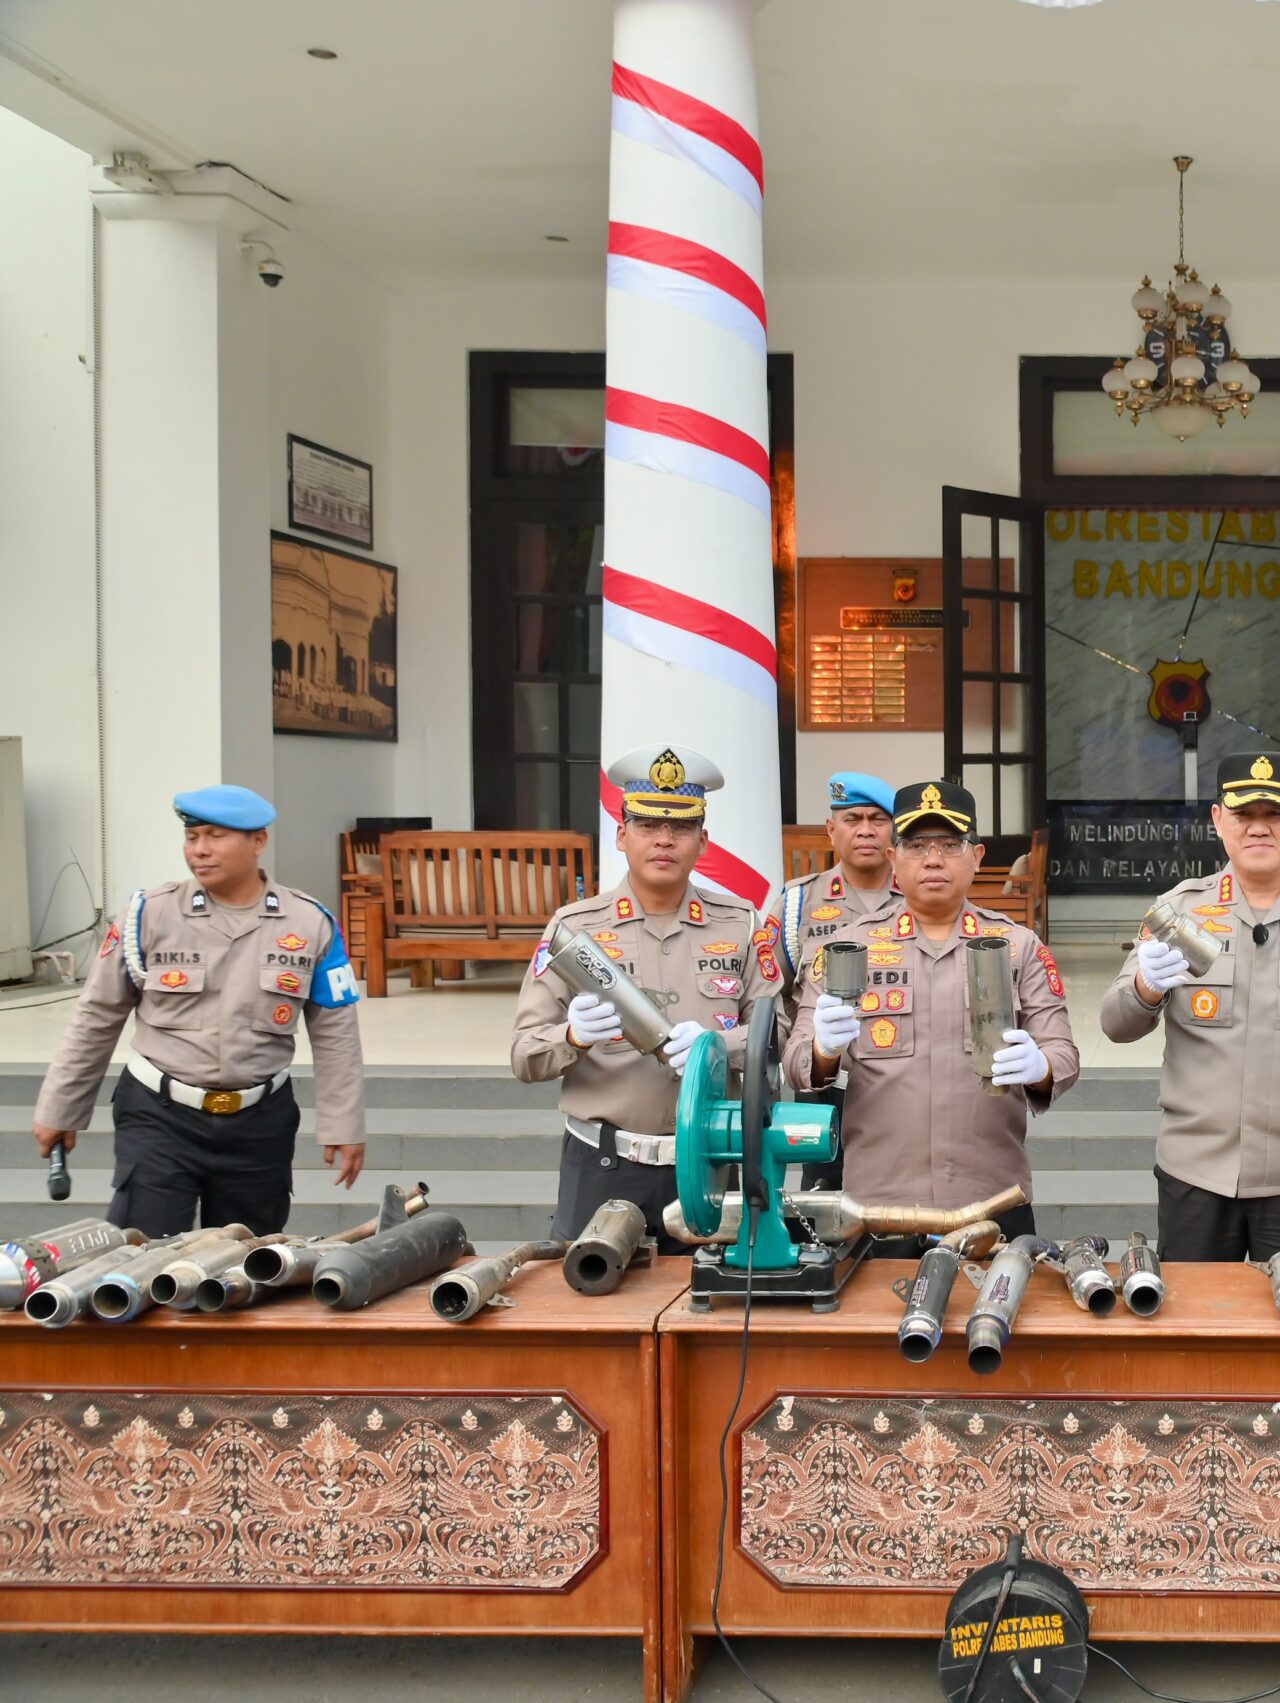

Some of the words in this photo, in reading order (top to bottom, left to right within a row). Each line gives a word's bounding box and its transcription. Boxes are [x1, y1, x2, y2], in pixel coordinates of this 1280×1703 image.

[1150, 342, 1165, 358] 9
[1070, 823, 1179, 842] MELINDUNGI
[1050, 859, 1090, 878] DAN
[1102, 859, 1202, 878] MELAYANI
[807, 924, 837, 938] ASEP
[154, 951, 201, 964] RIKI.S
[267, 953, 312, 969] POLRI
[697, 957, 742, 973] POLRI
[867, 971, 908, 985] EDI
[1018, 1629, 1065, 1649] BANDUNG
